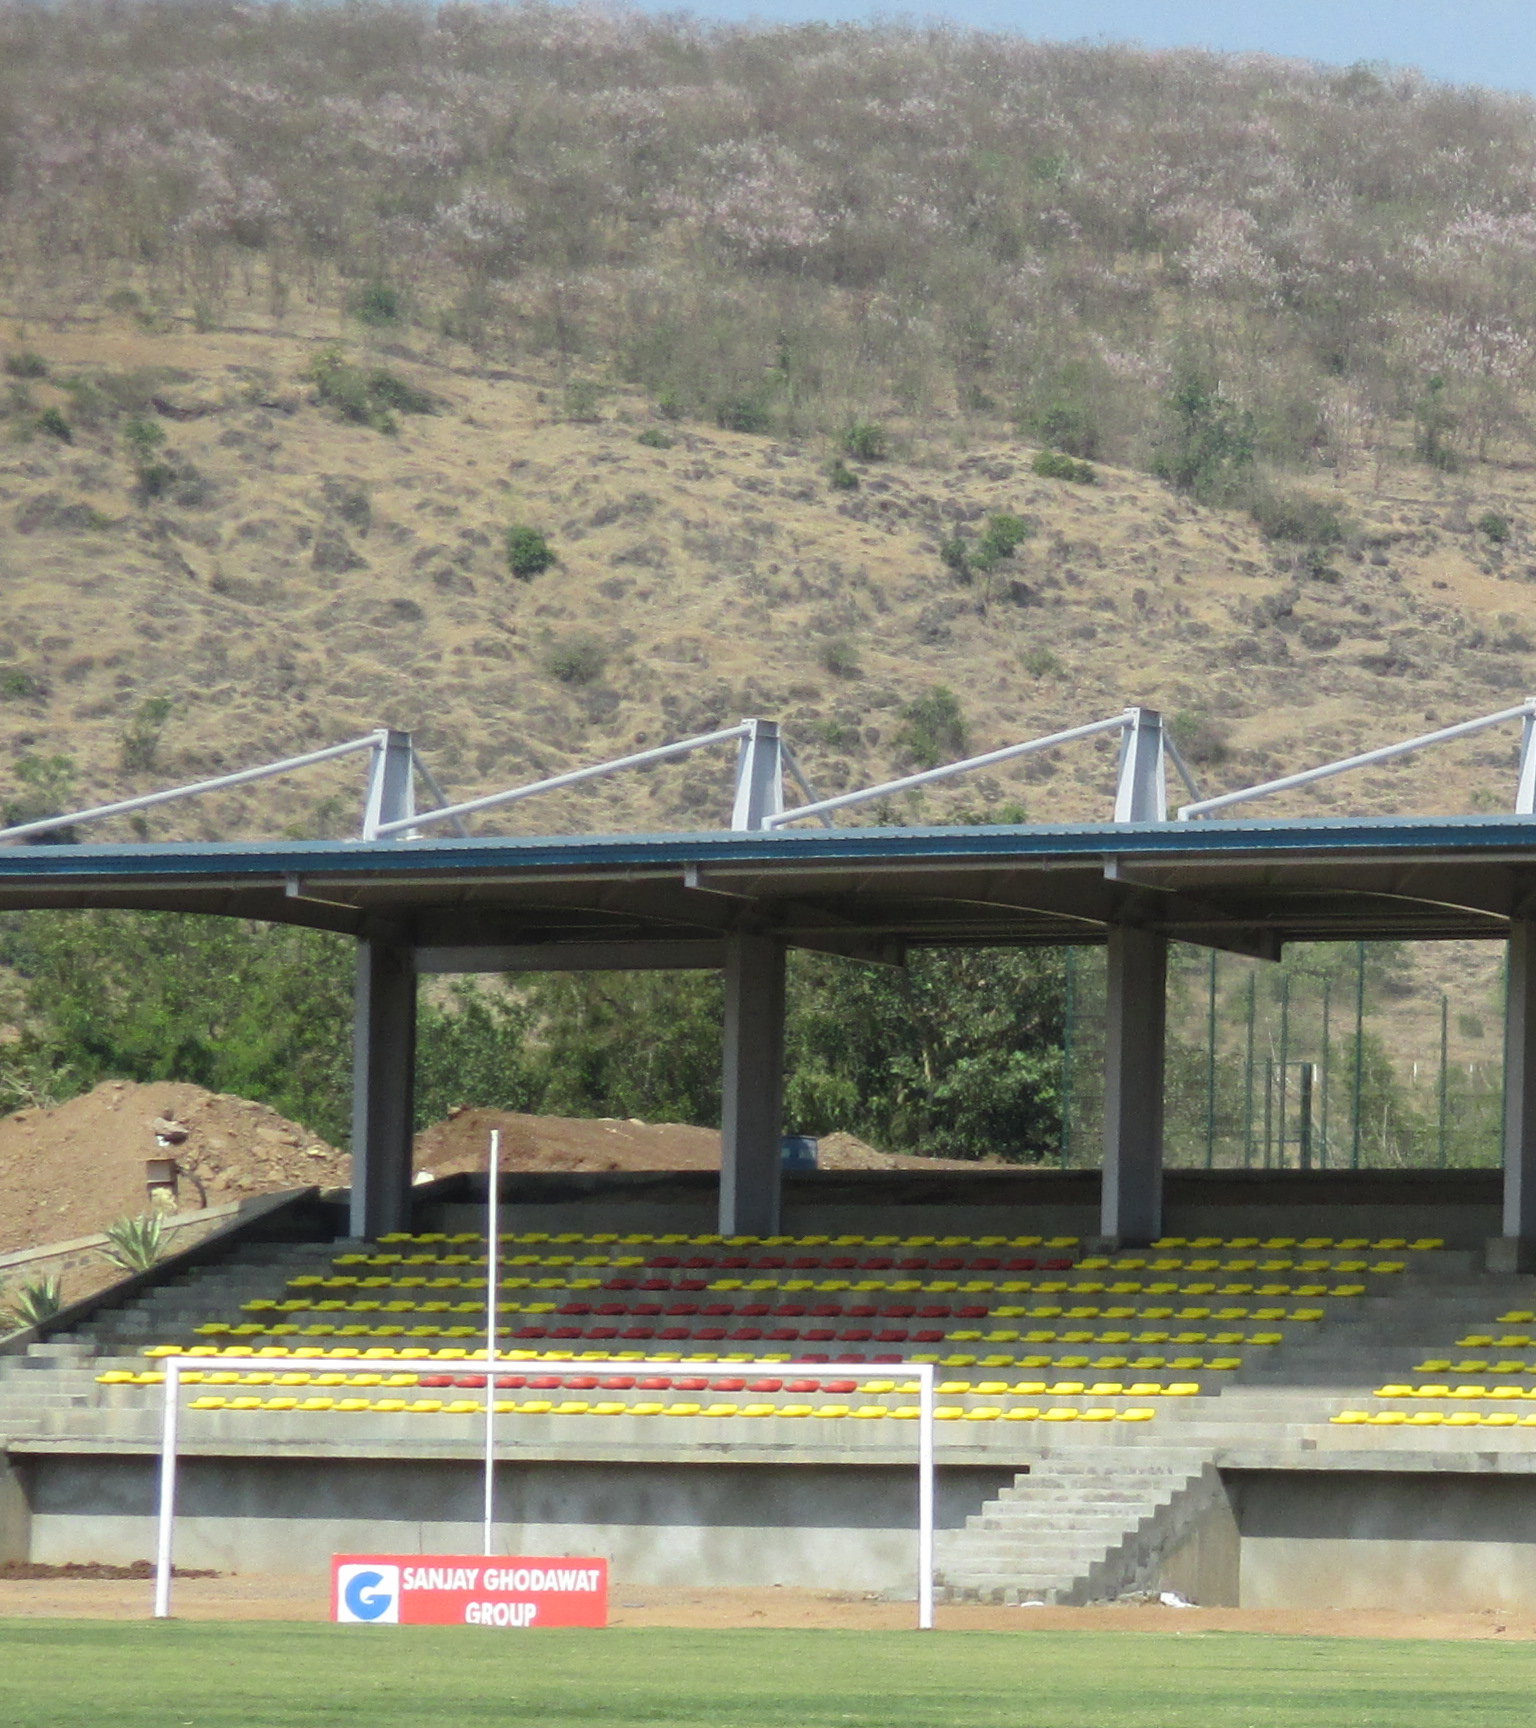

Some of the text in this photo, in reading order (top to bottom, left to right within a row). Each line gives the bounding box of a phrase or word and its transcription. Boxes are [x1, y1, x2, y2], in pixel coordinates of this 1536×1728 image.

[402, 1567, 600, 1592] SANJAY GHODAWAT
[464, 1602, 538, 1627] GROUP
